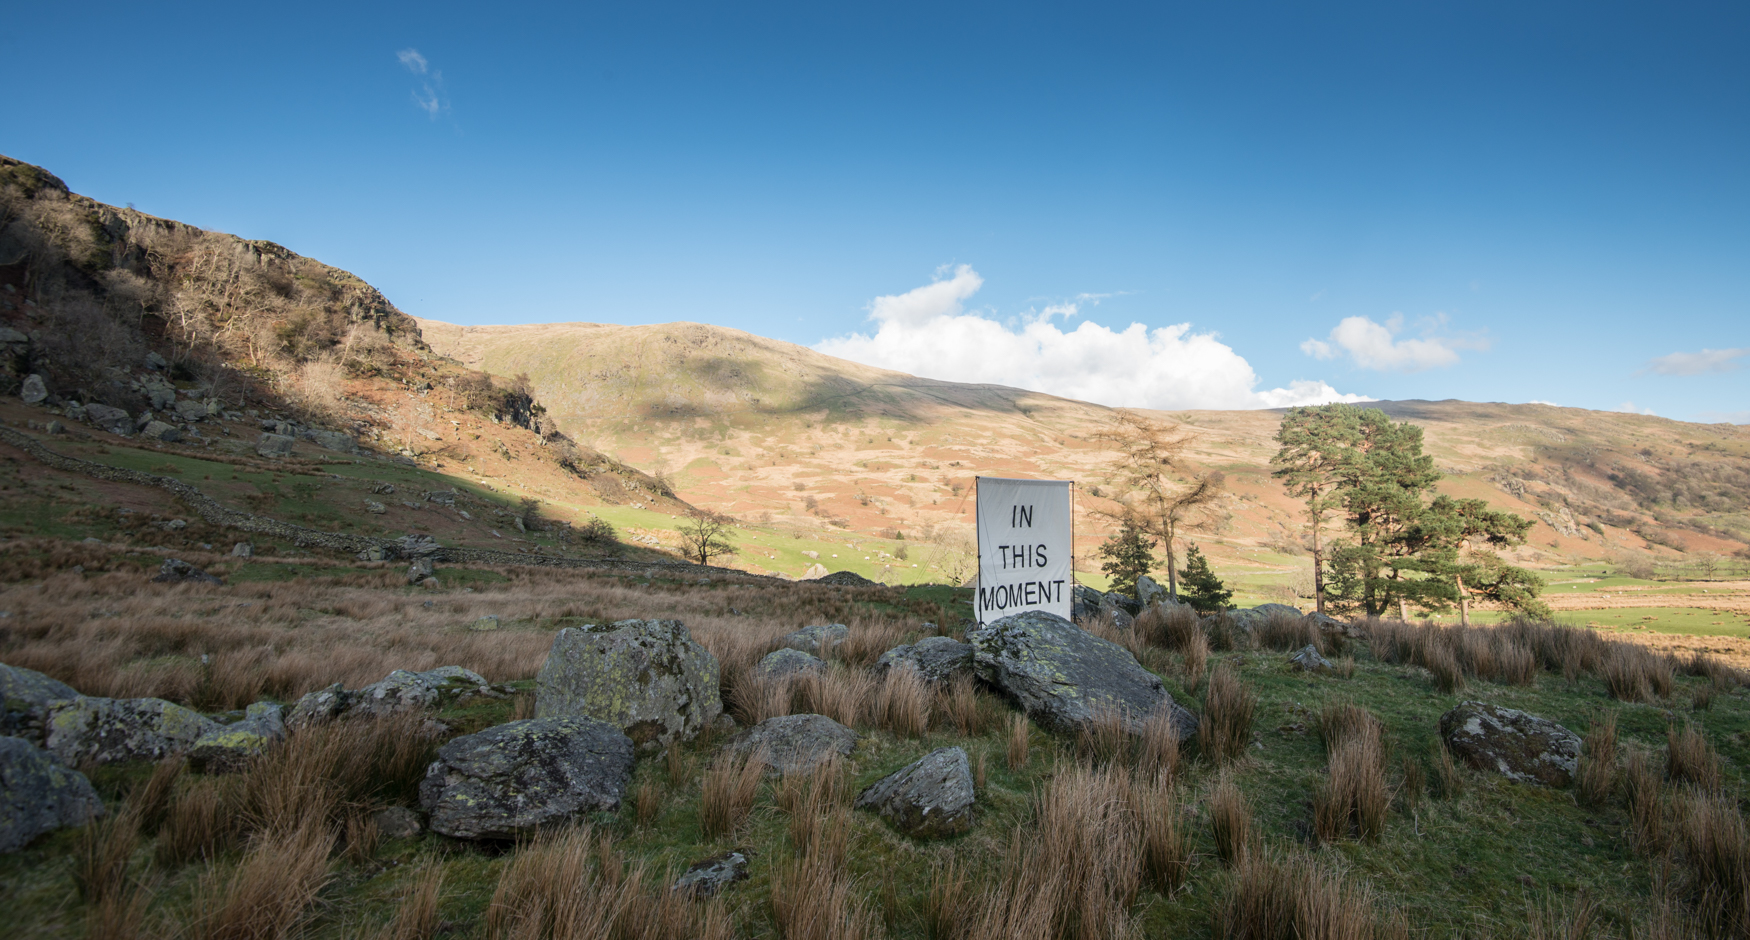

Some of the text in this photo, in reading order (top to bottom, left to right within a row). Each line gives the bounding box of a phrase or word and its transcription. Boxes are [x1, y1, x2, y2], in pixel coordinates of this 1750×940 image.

[1012, 505, 1033, 528] IN
[998, 544, 1047, 569] THIS
[979, 580, 1065, 611] MOMENT
